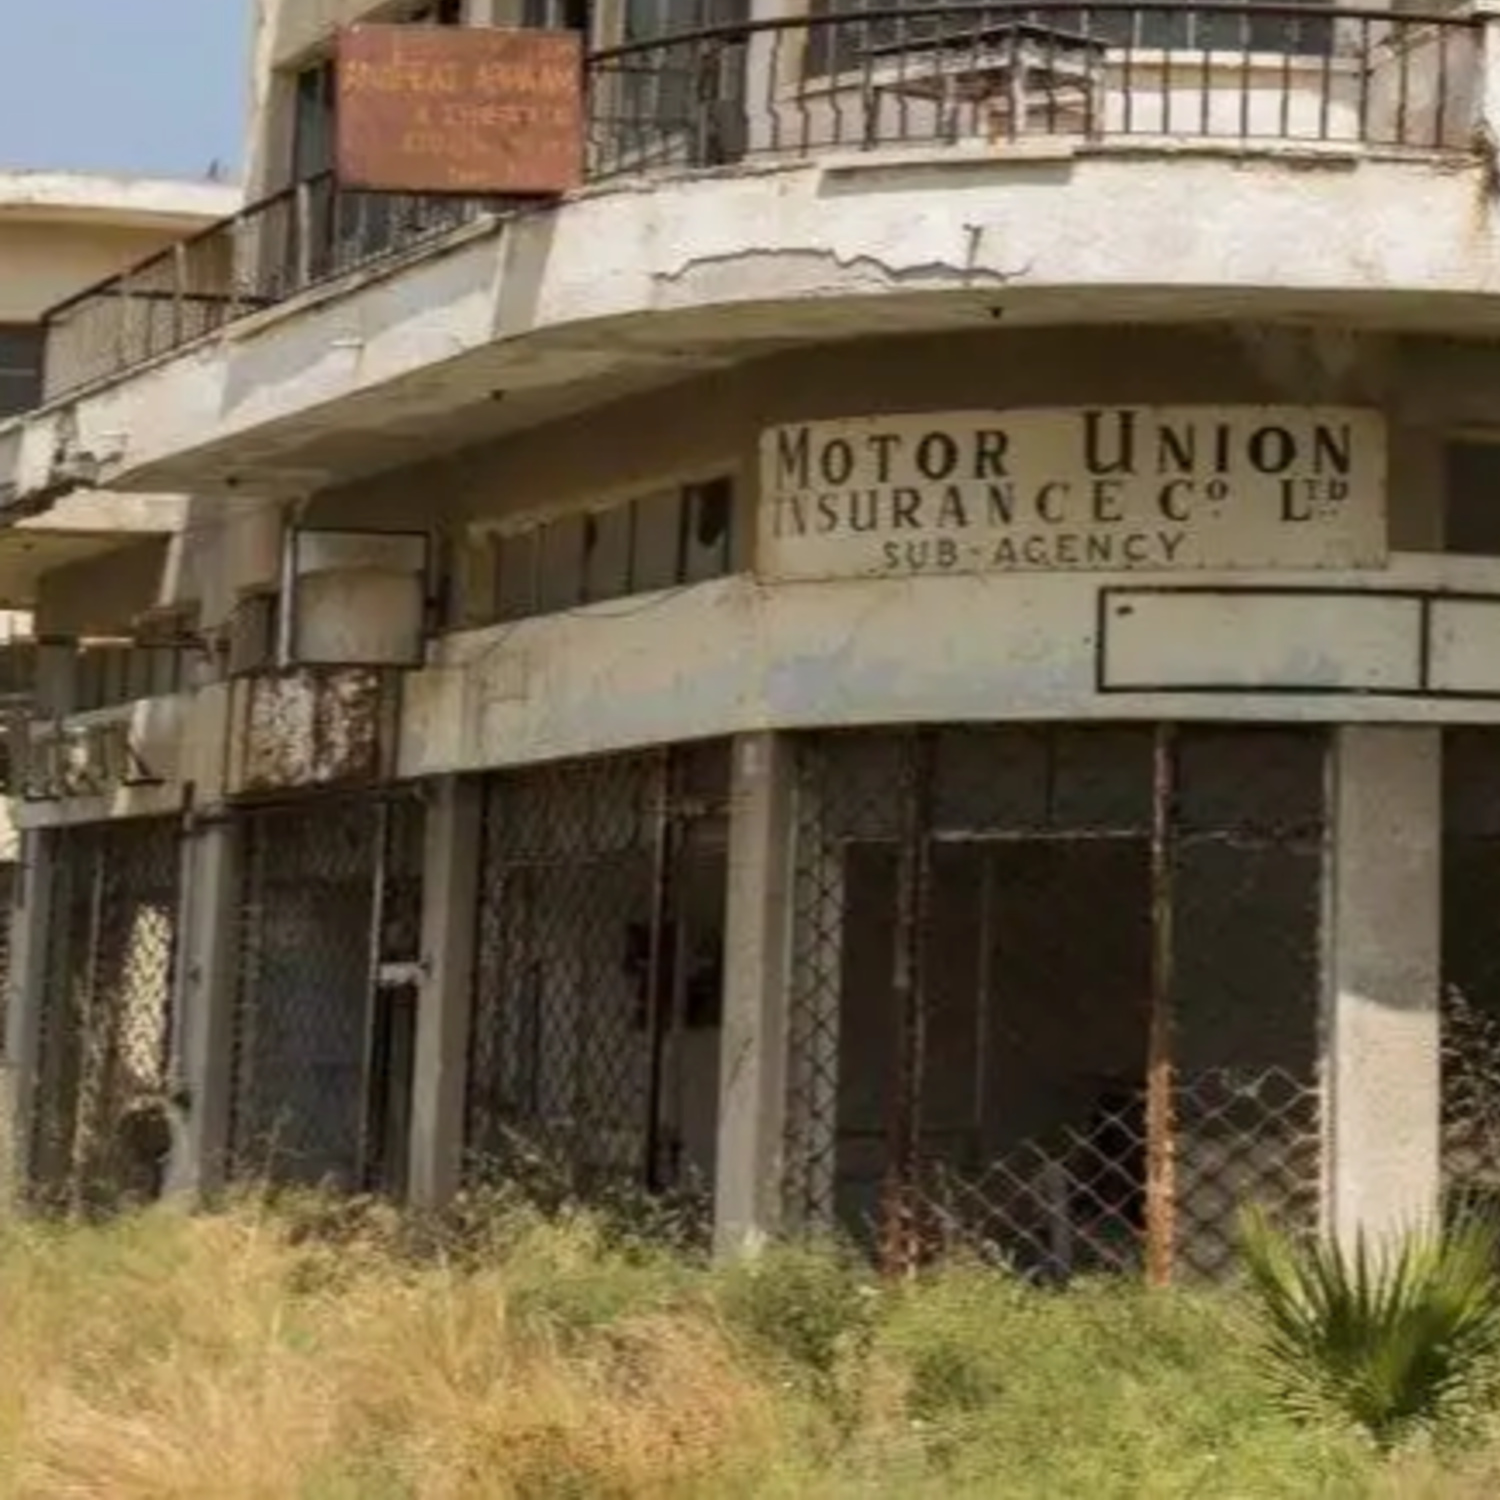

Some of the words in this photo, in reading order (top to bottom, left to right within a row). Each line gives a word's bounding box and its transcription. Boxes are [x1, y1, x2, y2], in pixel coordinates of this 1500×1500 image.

[774, 426, 1011, 490] MOTOR
[1082, 409, 1350, 476] UNION
[773, 478, 1124, 538] INSURANCE
